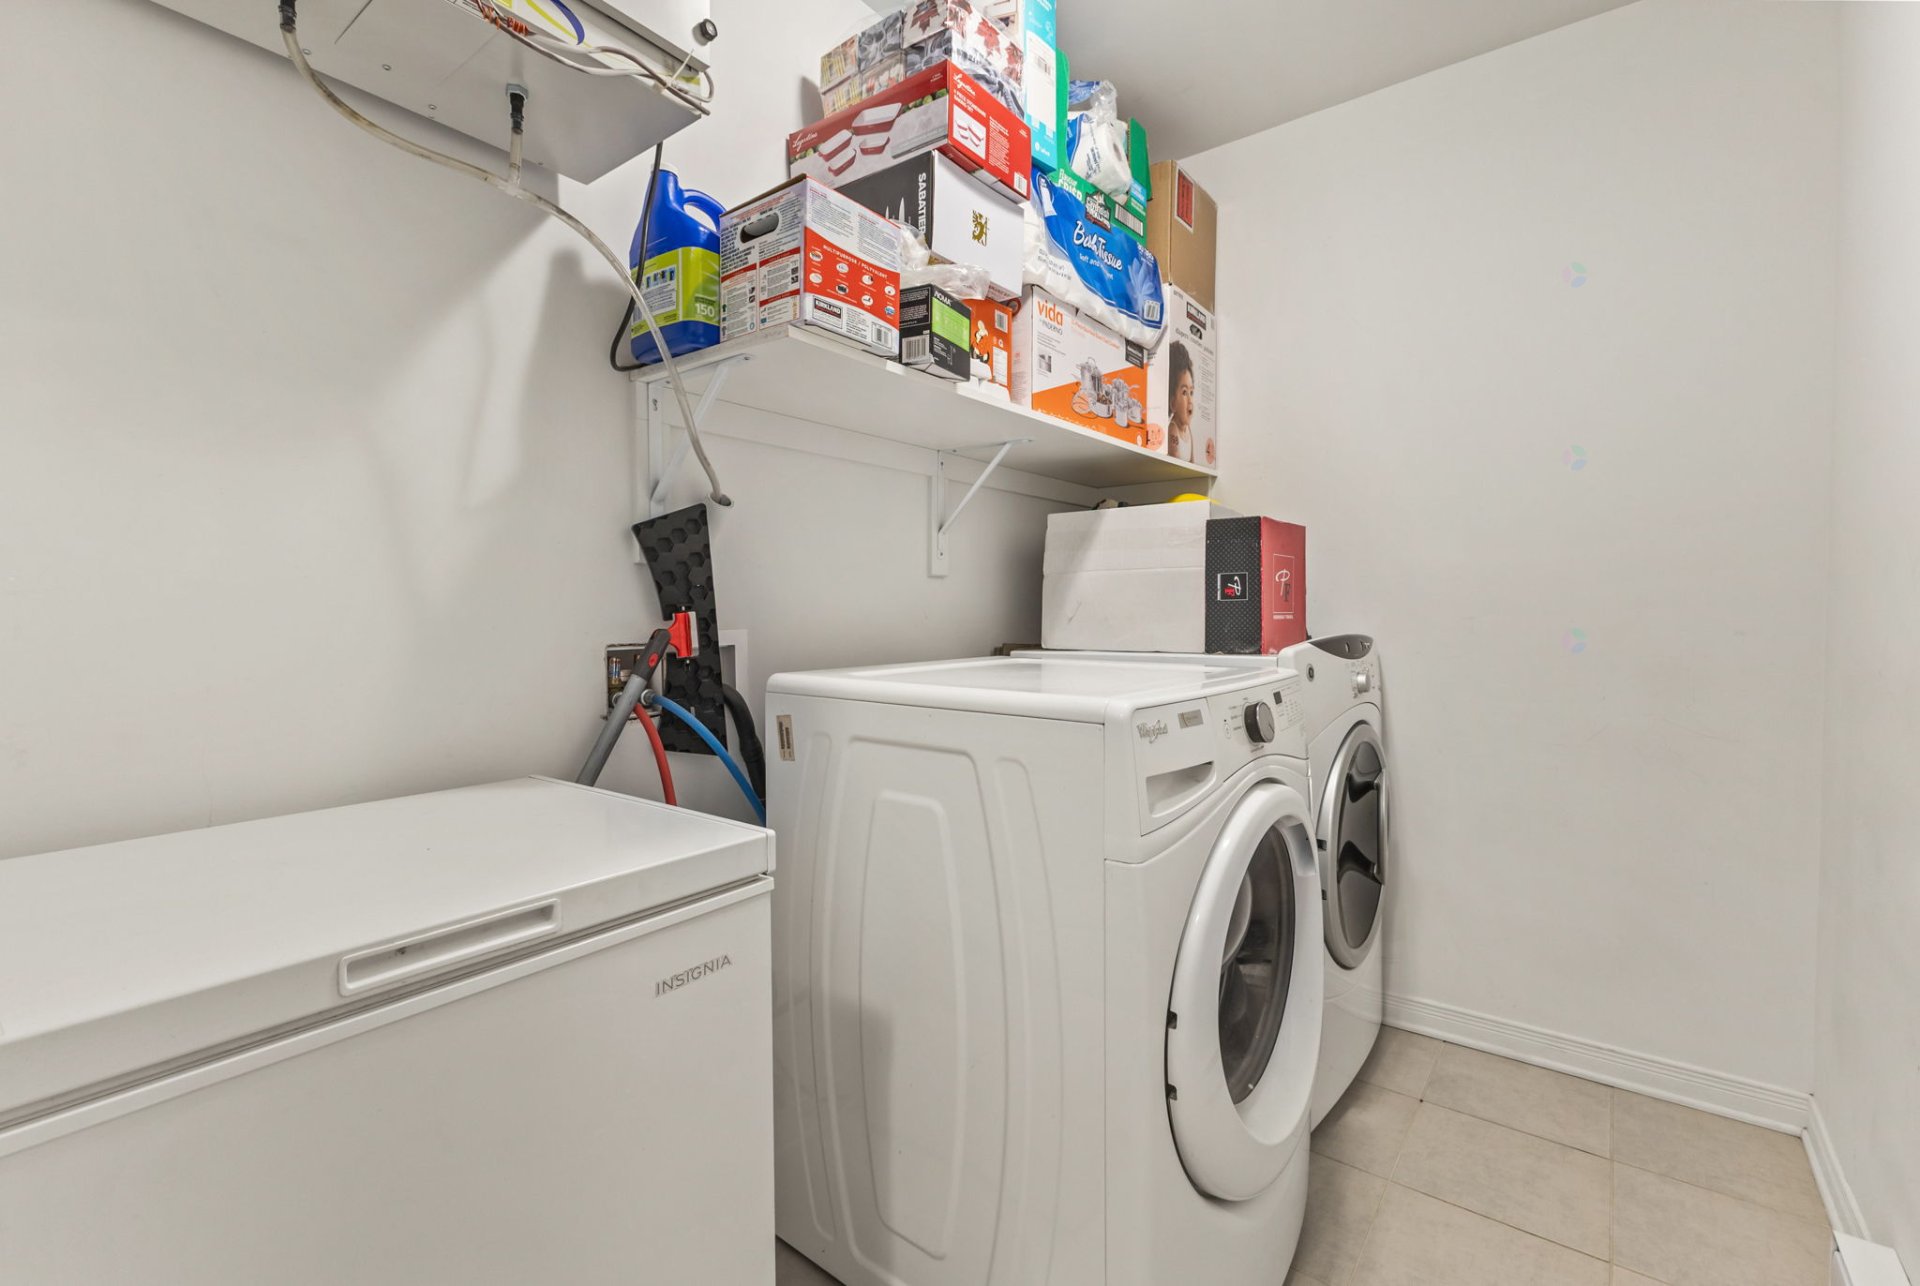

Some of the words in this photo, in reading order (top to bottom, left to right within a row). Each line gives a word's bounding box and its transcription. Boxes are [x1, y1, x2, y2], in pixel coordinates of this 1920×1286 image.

[1097, 236, 1123, 271] Tissue
[694, 302, 716, 318] 150
[1037, 299, 1064, 327] vida
[655, 954, 732, 998] INSIGNIA
